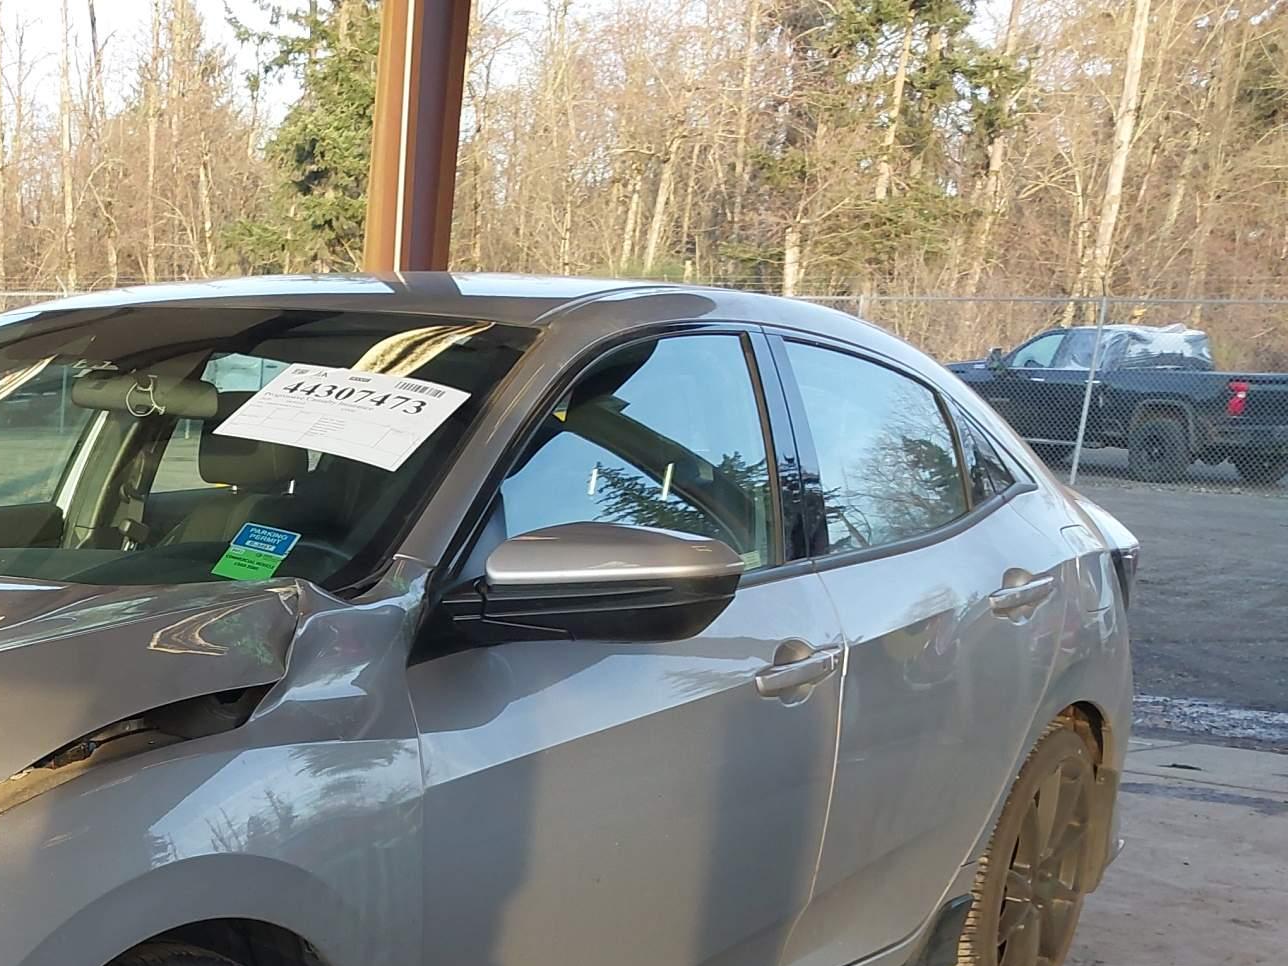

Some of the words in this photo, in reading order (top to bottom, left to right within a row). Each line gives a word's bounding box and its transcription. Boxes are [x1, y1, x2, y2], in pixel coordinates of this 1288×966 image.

[283, 381, 427, 415] 44307473
[249, 533, 280, 544] PERMIT
[250, 528, 288, 540] PARKING
